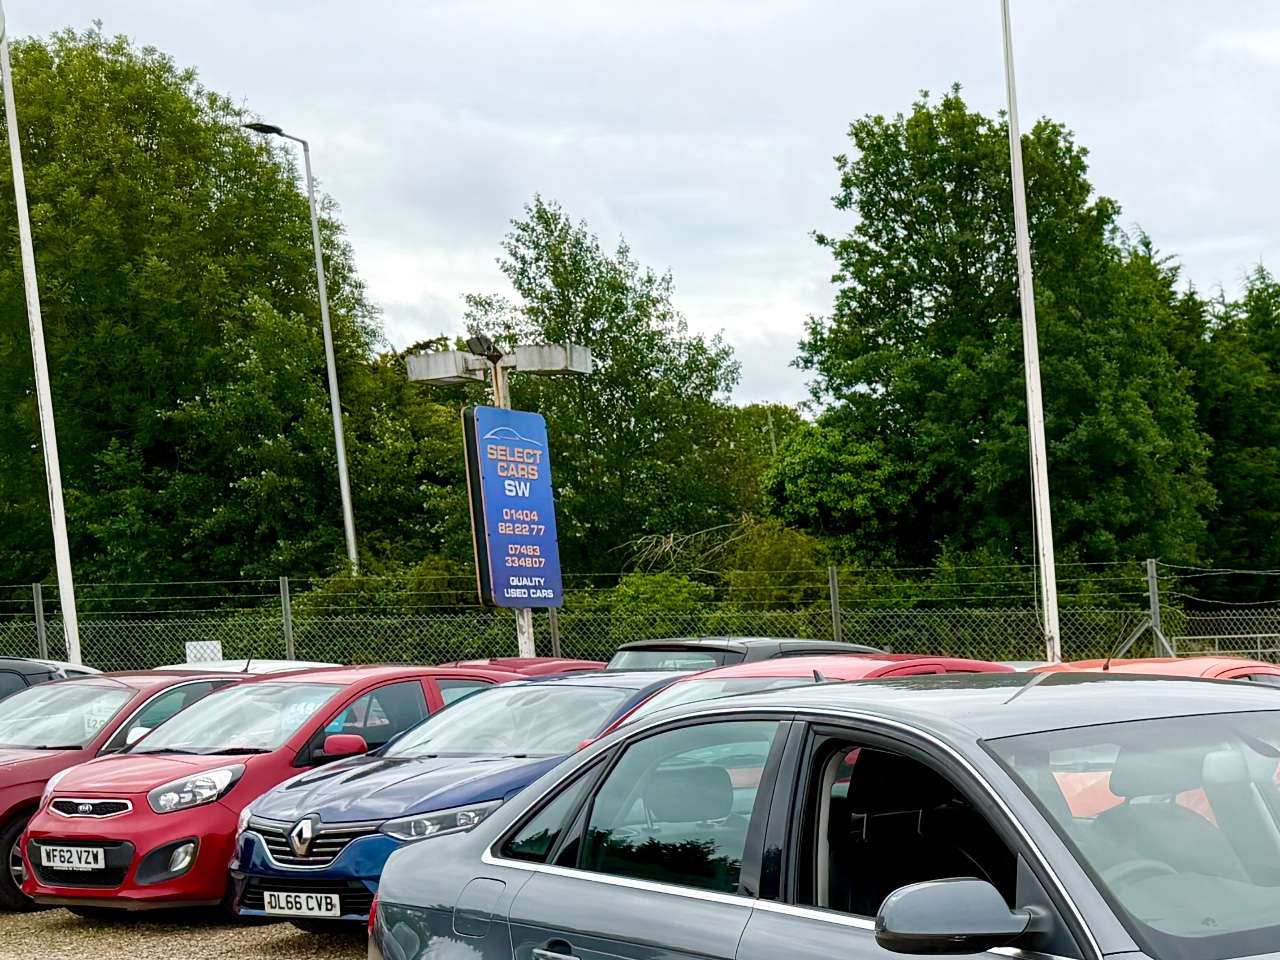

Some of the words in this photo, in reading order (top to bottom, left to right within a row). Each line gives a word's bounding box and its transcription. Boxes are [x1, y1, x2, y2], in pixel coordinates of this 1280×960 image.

[487, 444, 543, 464] SELECT
[497, 462, 539, 480] CARS
[504, 479, 530, 497] SW
[502, 508, 538, 521] 01404
[509, 576, 545, 586] QUALITY
[504, 588, 528, 598] USED
[530, 588, 554, 598] CARS
[45, 848, 73, 864] WF62
[76, 849, 99, 865] VZW
[269, 893, 302, 911] DL66
[306, 895, 334, 912] CVB
